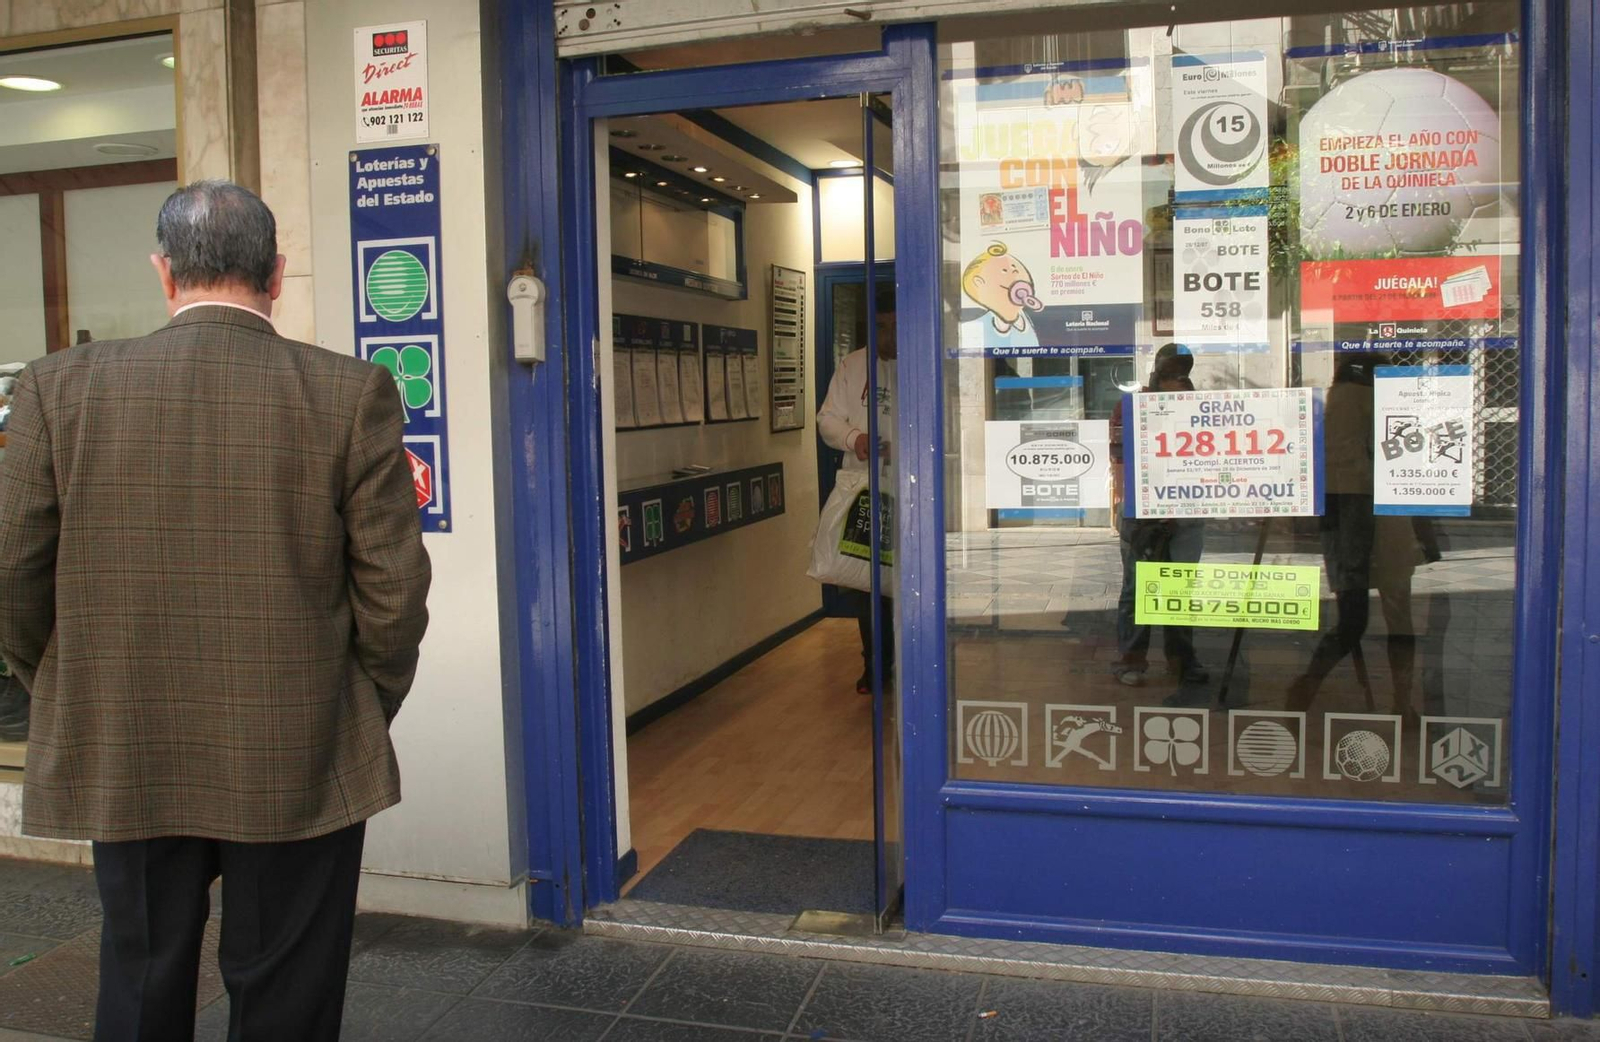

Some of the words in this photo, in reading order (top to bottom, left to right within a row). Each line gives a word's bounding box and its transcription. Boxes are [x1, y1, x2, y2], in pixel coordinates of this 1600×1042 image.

[374, 45, 408, 56] SECURITAS
[362, 52, 418, 84] Direct
[1182, 73, 1202, 82] Euro
[361, 87, 422, 107] ALARMA
[370, 115, 386, 126] 902
[389, 114, 403, 124] 121
[408, 112, 424, 122] 122
[1216, 116, 1245, 134] 15
[1320, 136, 1384, 151] EMPIEZA
[1389, 134, 1404, 148] EL
[1409, 130, 1441, 146] AÑO
[1446, 130, 1478, 144] CON
[356, 156, 415, 173] Loterías
[420, 156, 429, 171] y
[1207, 162, 1237, 170] Millones
[1320, 154, 1380, 173] DOBLE
[1385, 150, 1478, 171] JORNADA
[1000, 157, 1077, 189] CON
[357, 174, 424, 192] Apuestas
[1342, 176, 1360, 190] DE
[1364, 175, 1382, 190] LA
[1386, 172, 1456, 189] QUINIELA
[357, 194, 379, 208] del
[384, 190, 434, 206] Estado
[1049, 188, 1088, 223] EL
[1346, 206, 1354, 220] 2
[1357, 208, 1364, 222] y
[1368, 206, 1376, 219] 6
[1379, 204, 1398, 218] DE
[1402, 202, 1450, 218] ENERO
[1050, 211, 1143, 258] NIÑO
[1184, 226, 1211, 235] Bono
[1232, 224, 1257, 233] Loto
[1217, 244, 1260, 257] BOTE
[1184, 271, 1261, 292] BOTE
[1374, 275, 1438, 291] JUÉGALA!
[1060, 288, 1086, 296] premios
[1200, 302, 1242, 318] 558
[1396, 326, 1428, 334] Quiniela
[992, 346, 1009, 356] Que
[1012, 346, 1020, 354] la
[1022, 347, 1048, 355] suerte
[1050, 346, 1059, 354] te
[1060, 345, 1106, 356] acompañe.
[1342, 341, 1360, 350] Que
[1362, 340, 1371, 349] la
[1372, 341, 1402, 349] suerte
[1404, 340, 1414, 348] te
[1416, 338, 1466, 350] acompañe.
[1200, 400, 1244, 414] GRAN
[1190, 414, 1255, 428] PREMIO
[1381, 416, 1468, 461] BOTE
[1010, 454, 1090, 465] 10.875.000
[1224, 457, 1264, 466] ACIERTOS
[1389, 469, 1448, 478] 1.335.000
[1452, 469, 1458, 478] €
[1022, 484, 1078, 496] BOTE
[1154, 485, 1241, 500] VENDIDO
[1246, 478, 1294, 501] AQUÍ
[1392, 488, 1446, 496] 1.359.000
[1450, 488, 1456, 496] €
[1185, 578, 1269, 590] BOTE
